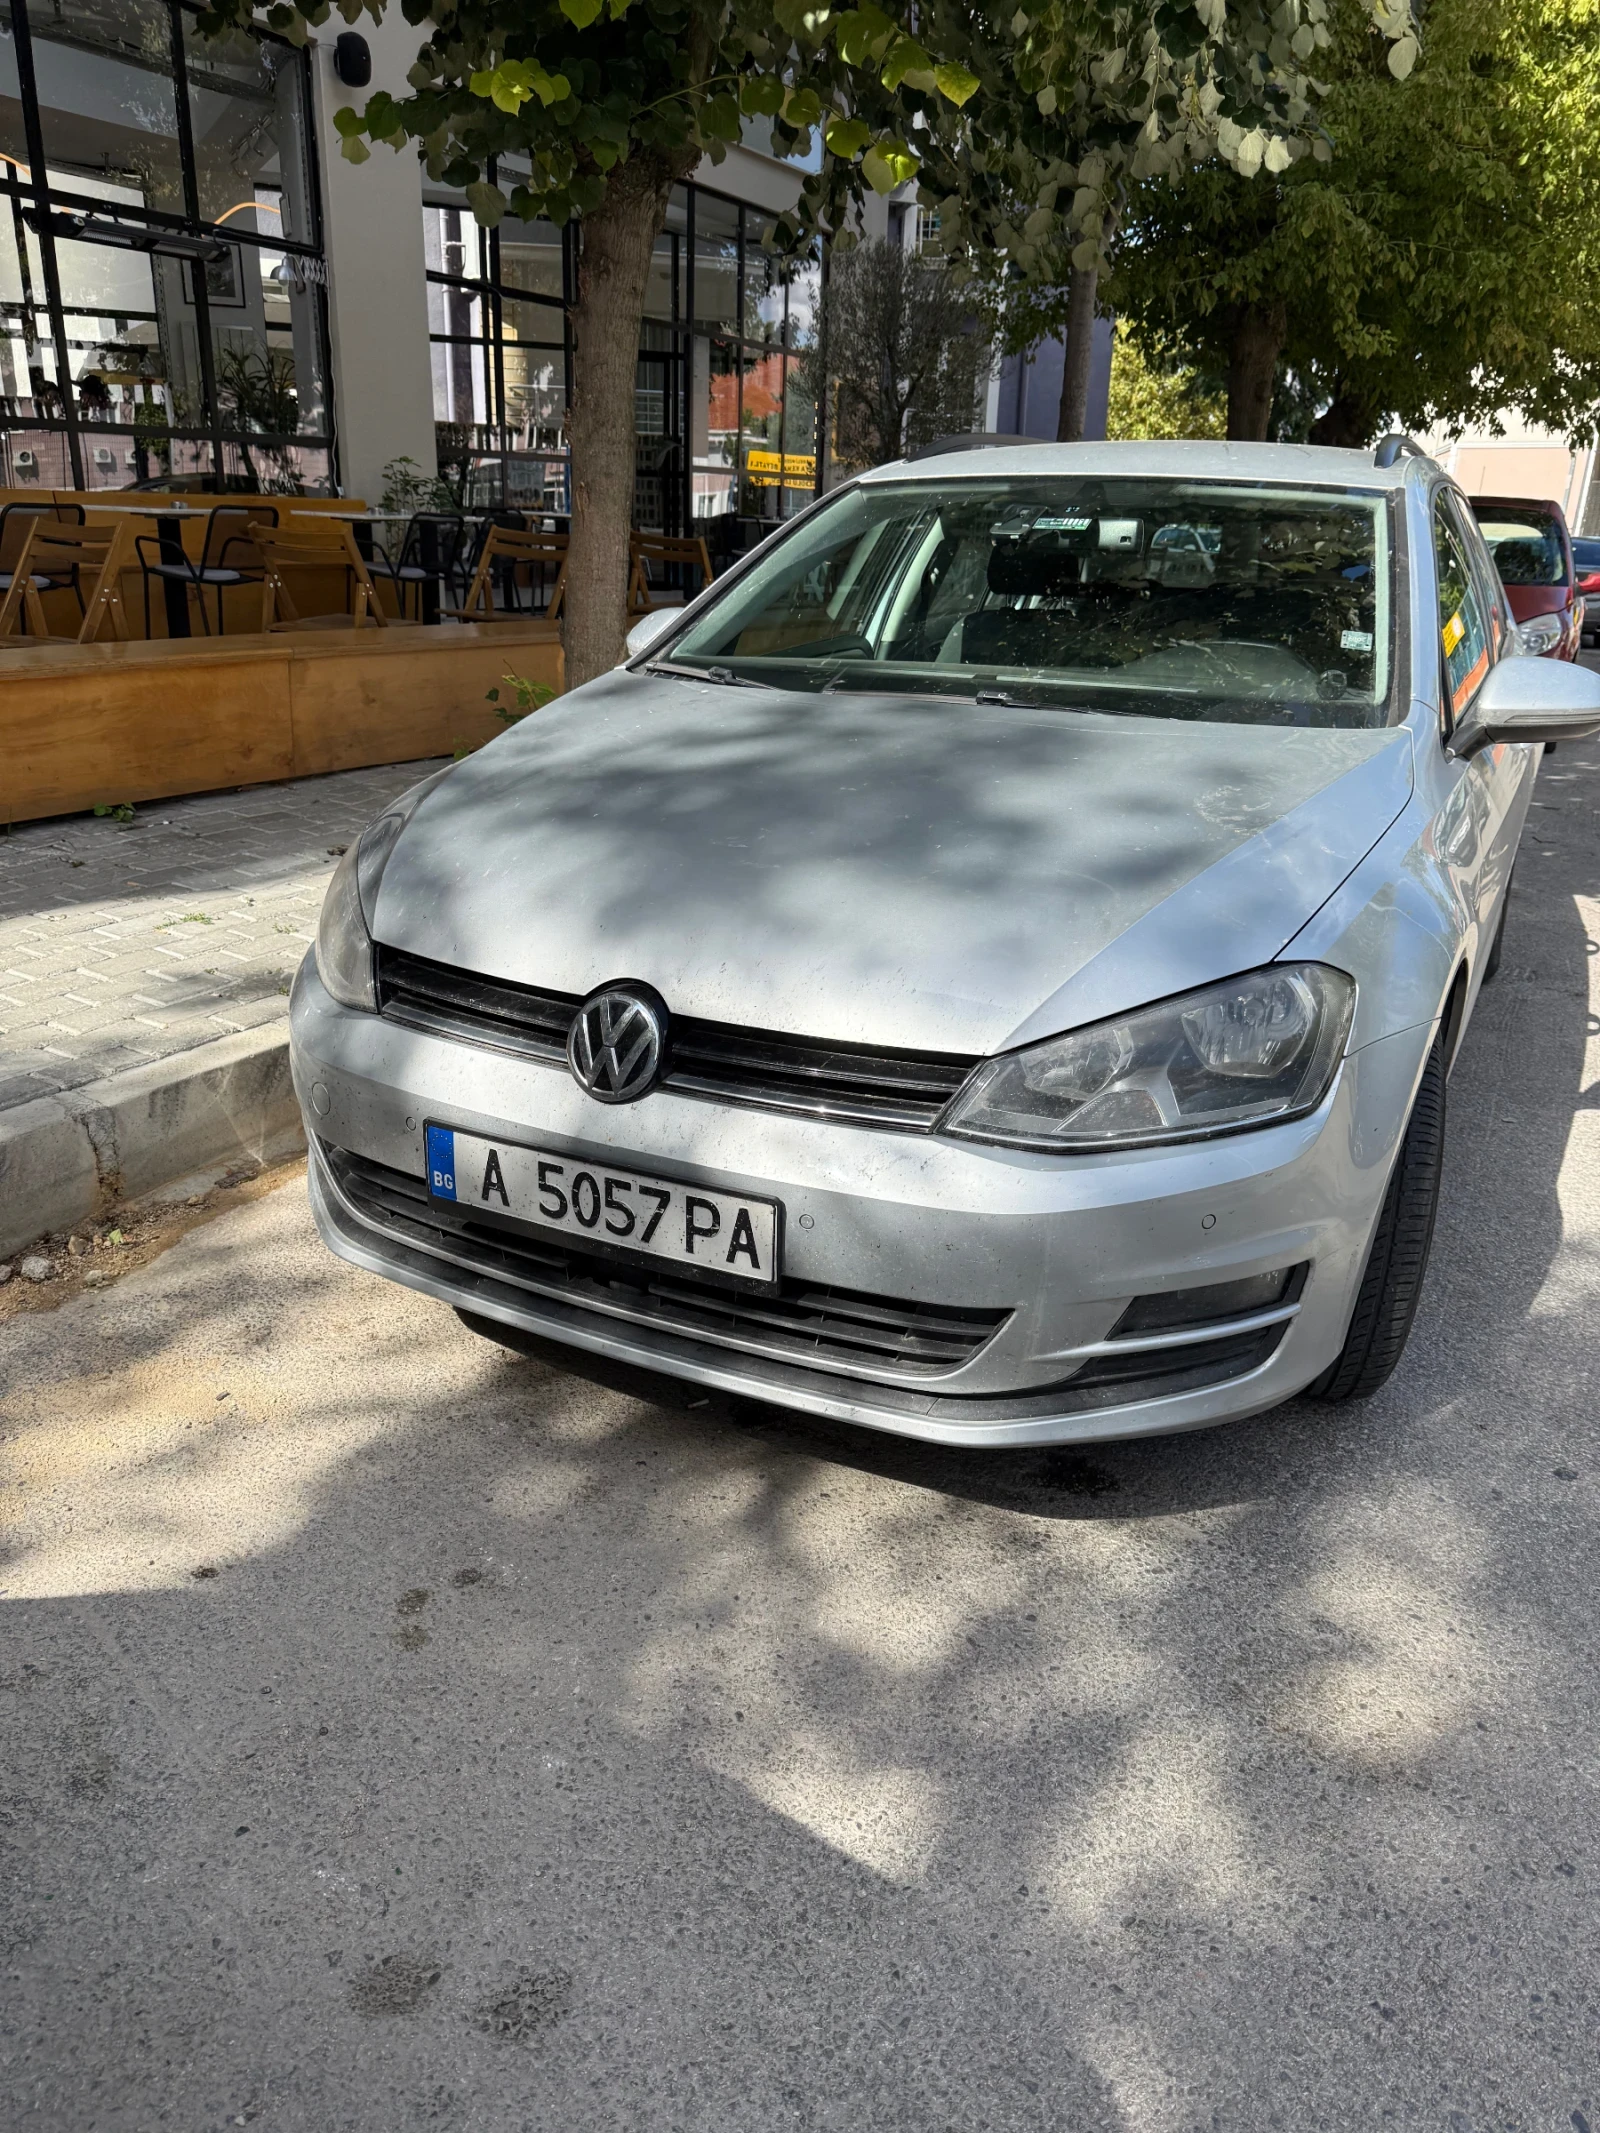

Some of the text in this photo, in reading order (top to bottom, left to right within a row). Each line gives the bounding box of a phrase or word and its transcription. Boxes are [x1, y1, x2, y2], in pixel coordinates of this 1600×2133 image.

[433, 1170, 454, 1190] BG
[481, 1148, 761, 1270] A 5057 PA
